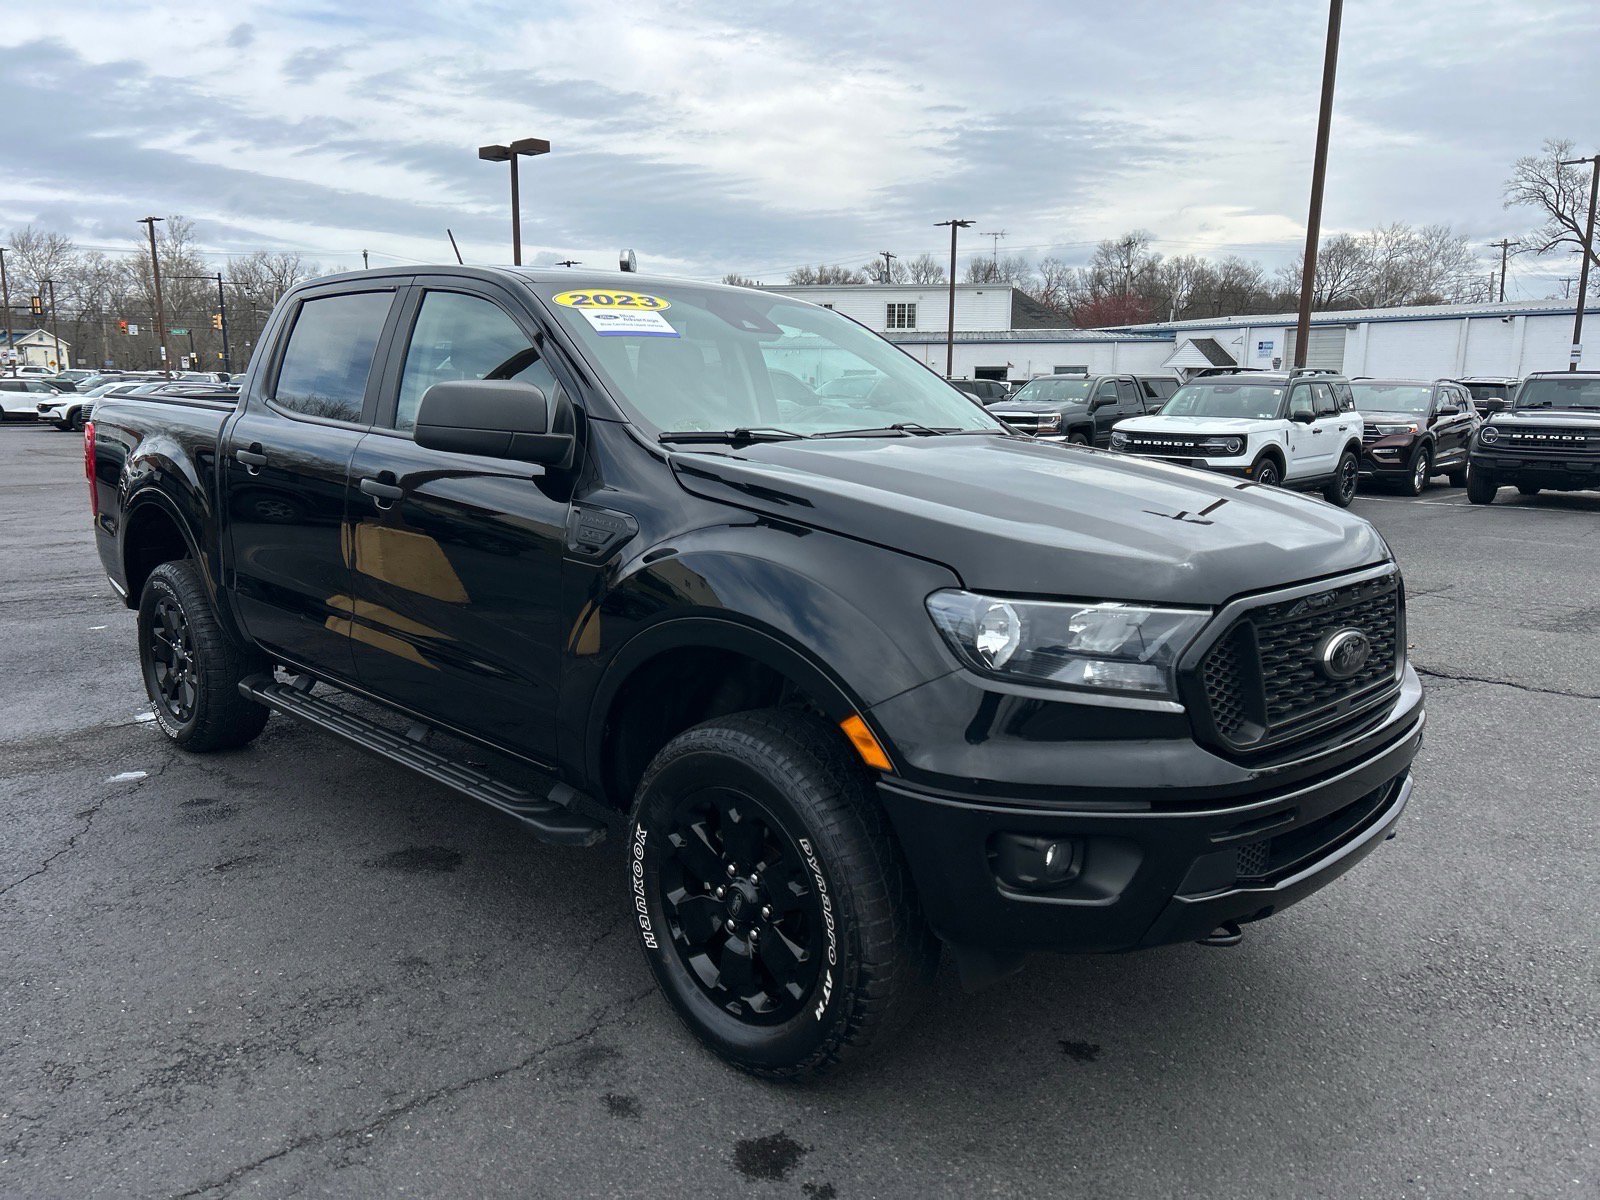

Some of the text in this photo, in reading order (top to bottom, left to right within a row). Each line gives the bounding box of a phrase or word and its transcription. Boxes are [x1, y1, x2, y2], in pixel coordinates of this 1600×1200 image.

[569, 294, 661, 308] 2023
[1511, 433, 1585, 441] BRONCO
[1133, 439, 1195, 447] BRONCO
